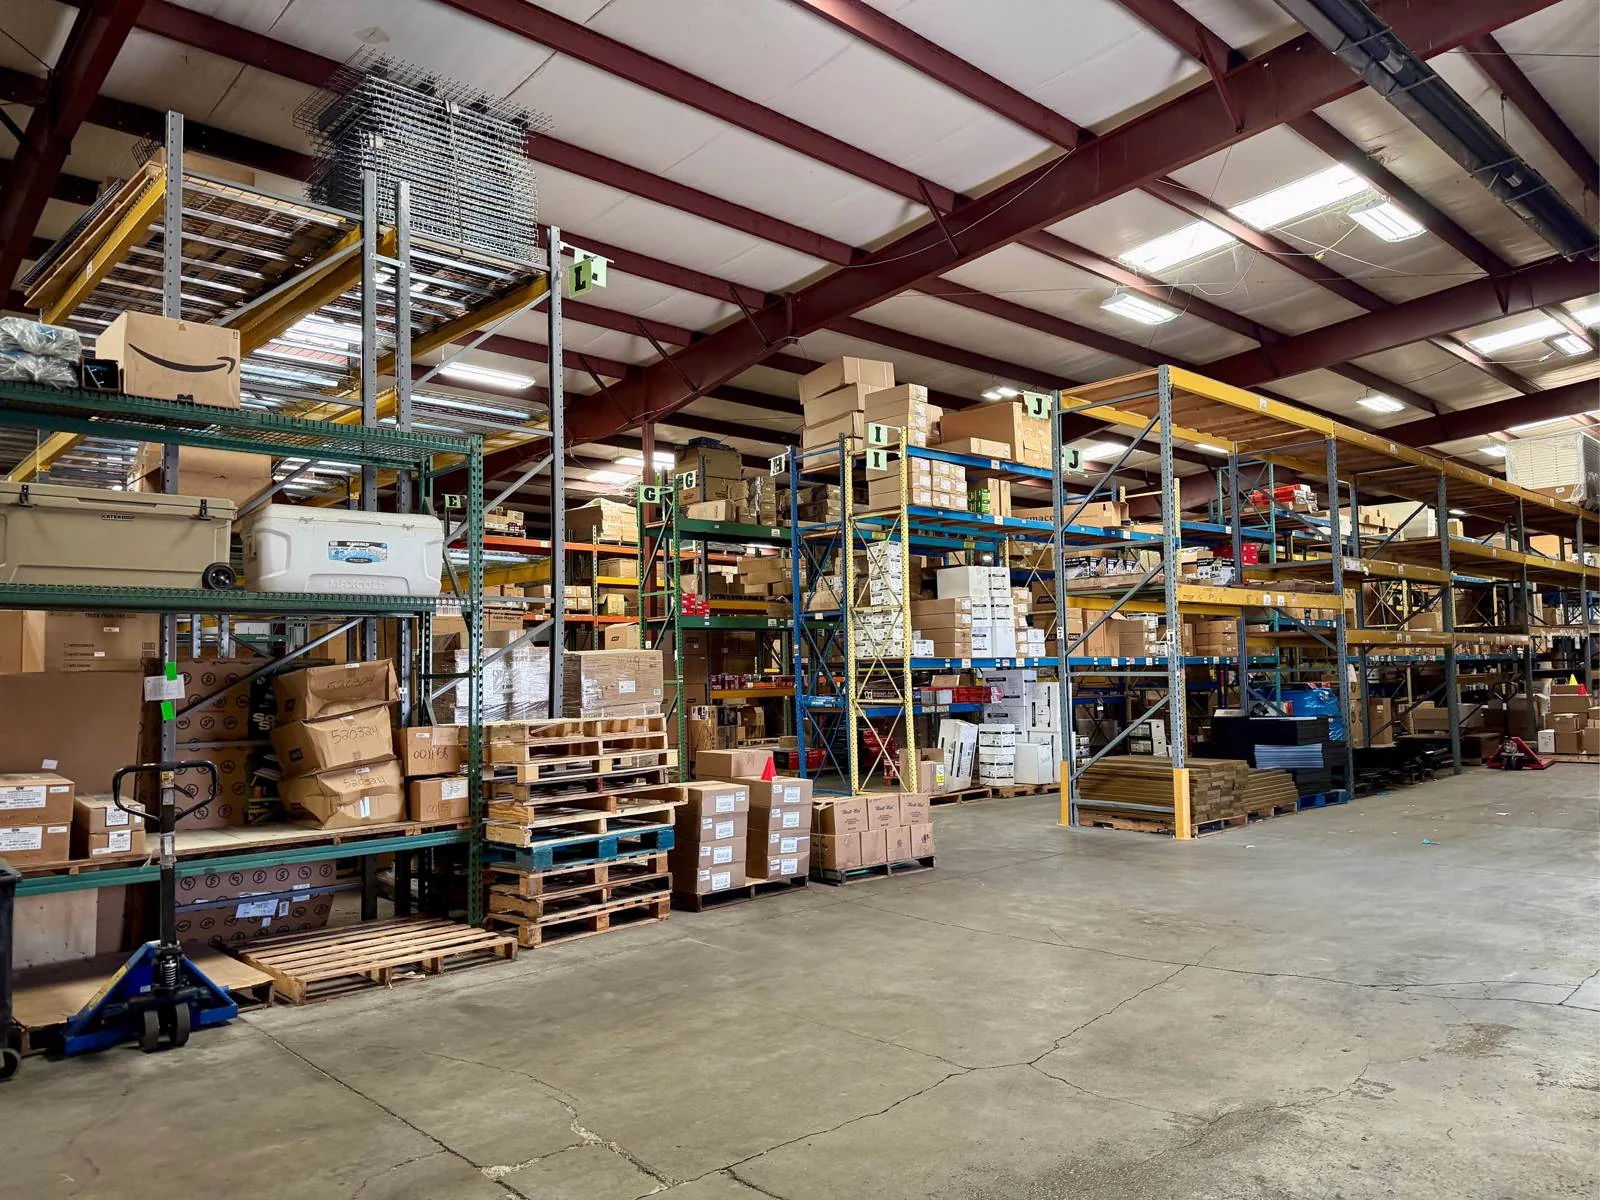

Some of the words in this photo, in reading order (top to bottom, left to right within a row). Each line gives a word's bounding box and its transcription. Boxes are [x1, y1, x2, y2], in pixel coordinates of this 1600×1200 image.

[574, 265, 586, 292] L
[1033, 397, 1043, 415] J
[874, 426, 881, 442] I
[873, 451, 880, 468] I
[1069, 449, 1079, 469] J
[685, 472, 694, 489] G
[643, 487, 656, 501] G
